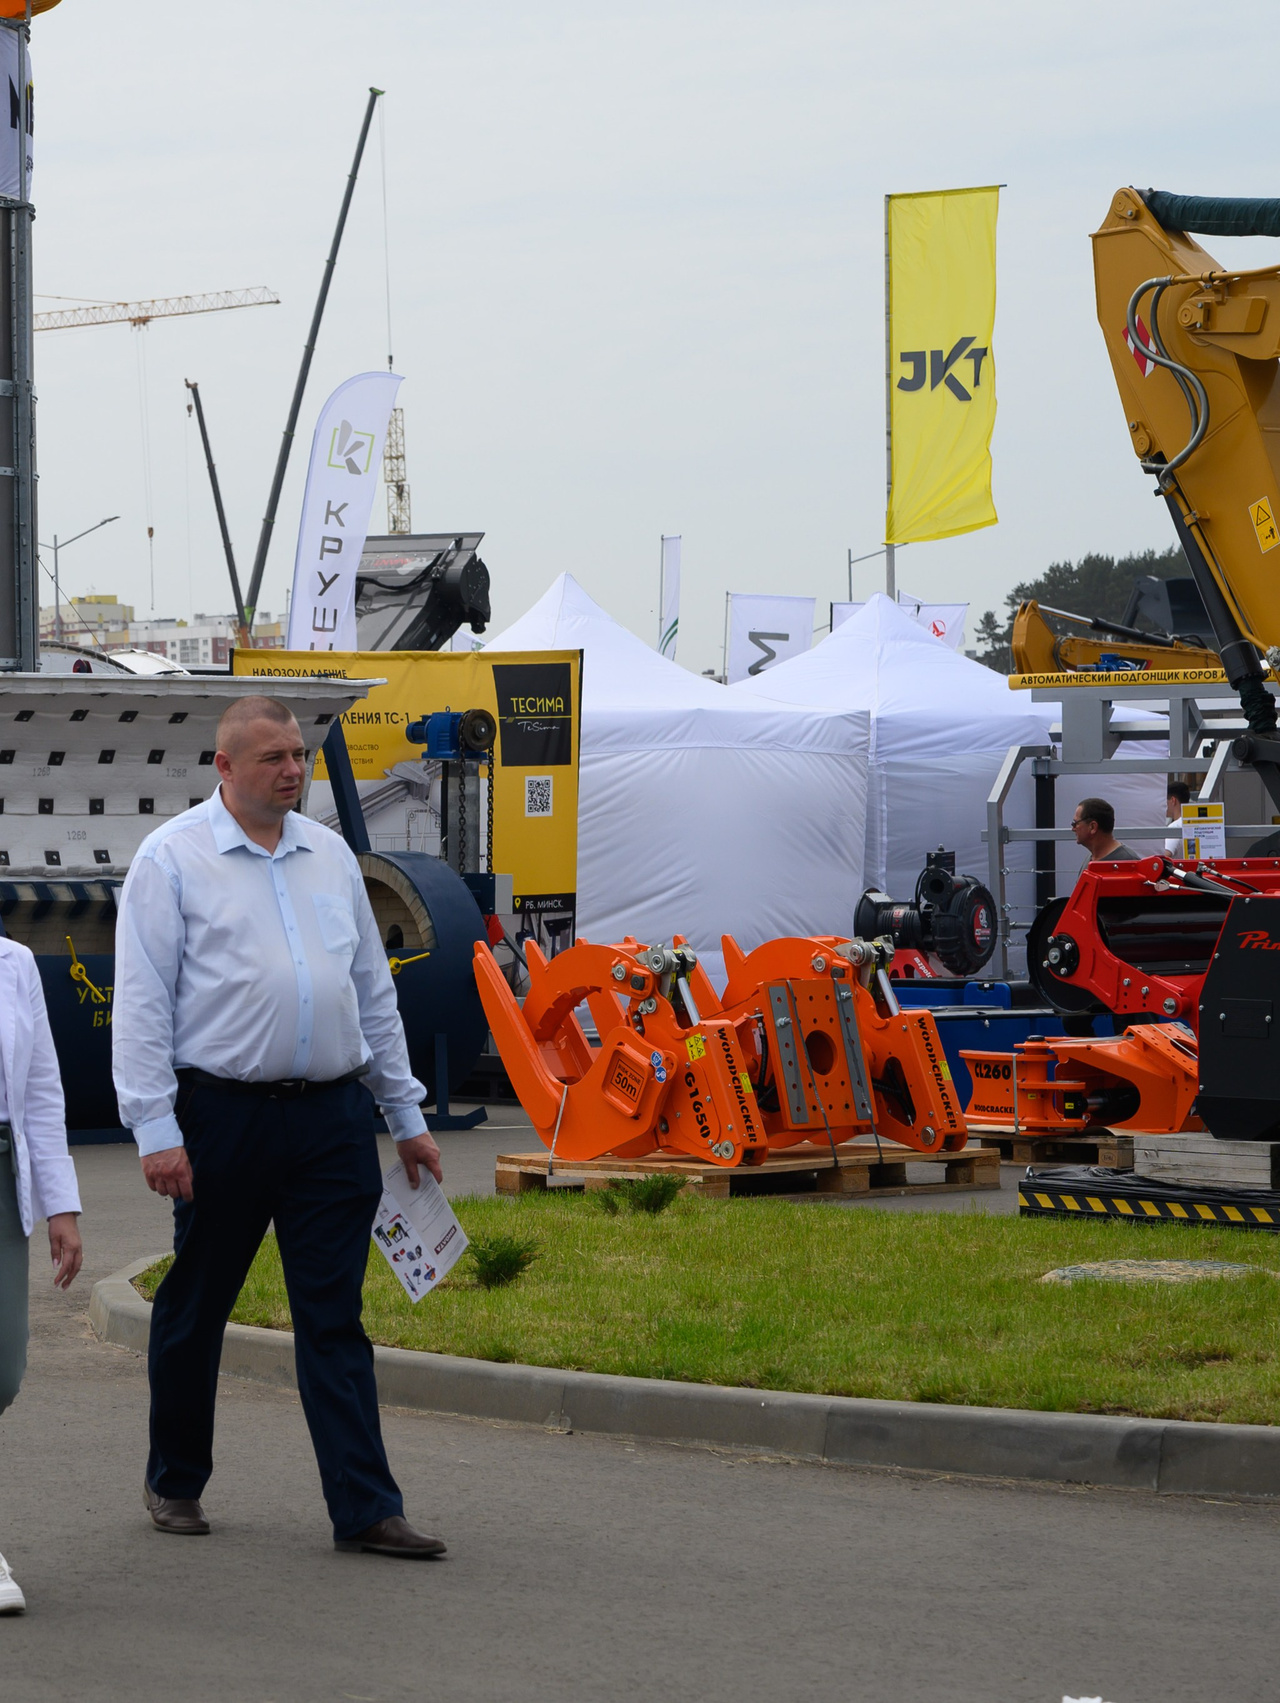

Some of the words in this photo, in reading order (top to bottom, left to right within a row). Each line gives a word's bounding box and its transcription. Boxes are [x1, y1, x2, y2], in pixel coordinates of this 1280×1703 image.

[896, 335, 988, 402] JKT
[1020, 672, 1111, 685] АВТОМАТИЧЕСКИЙ
[1114, 671, 1180, 683] ПОДГОНЩИК
[1183, 669, 1218, 681] КОРОВ
[510, 696, 564, 713] ТЕСИМА
[32, 766, 51, 777] 1260
[166, 767, 187, 778] 1260
[67, 830, 87, 841] 1260
[917, 1017, 957, 1129] WOODCRACKER
[974, 1063, 1012, 1080] CL260
[614, 1072, 638, 1098] 50m
[717, 1027, 758, 1143] WOODCRACKER
[684, 1071, 711, 1139] G1650
